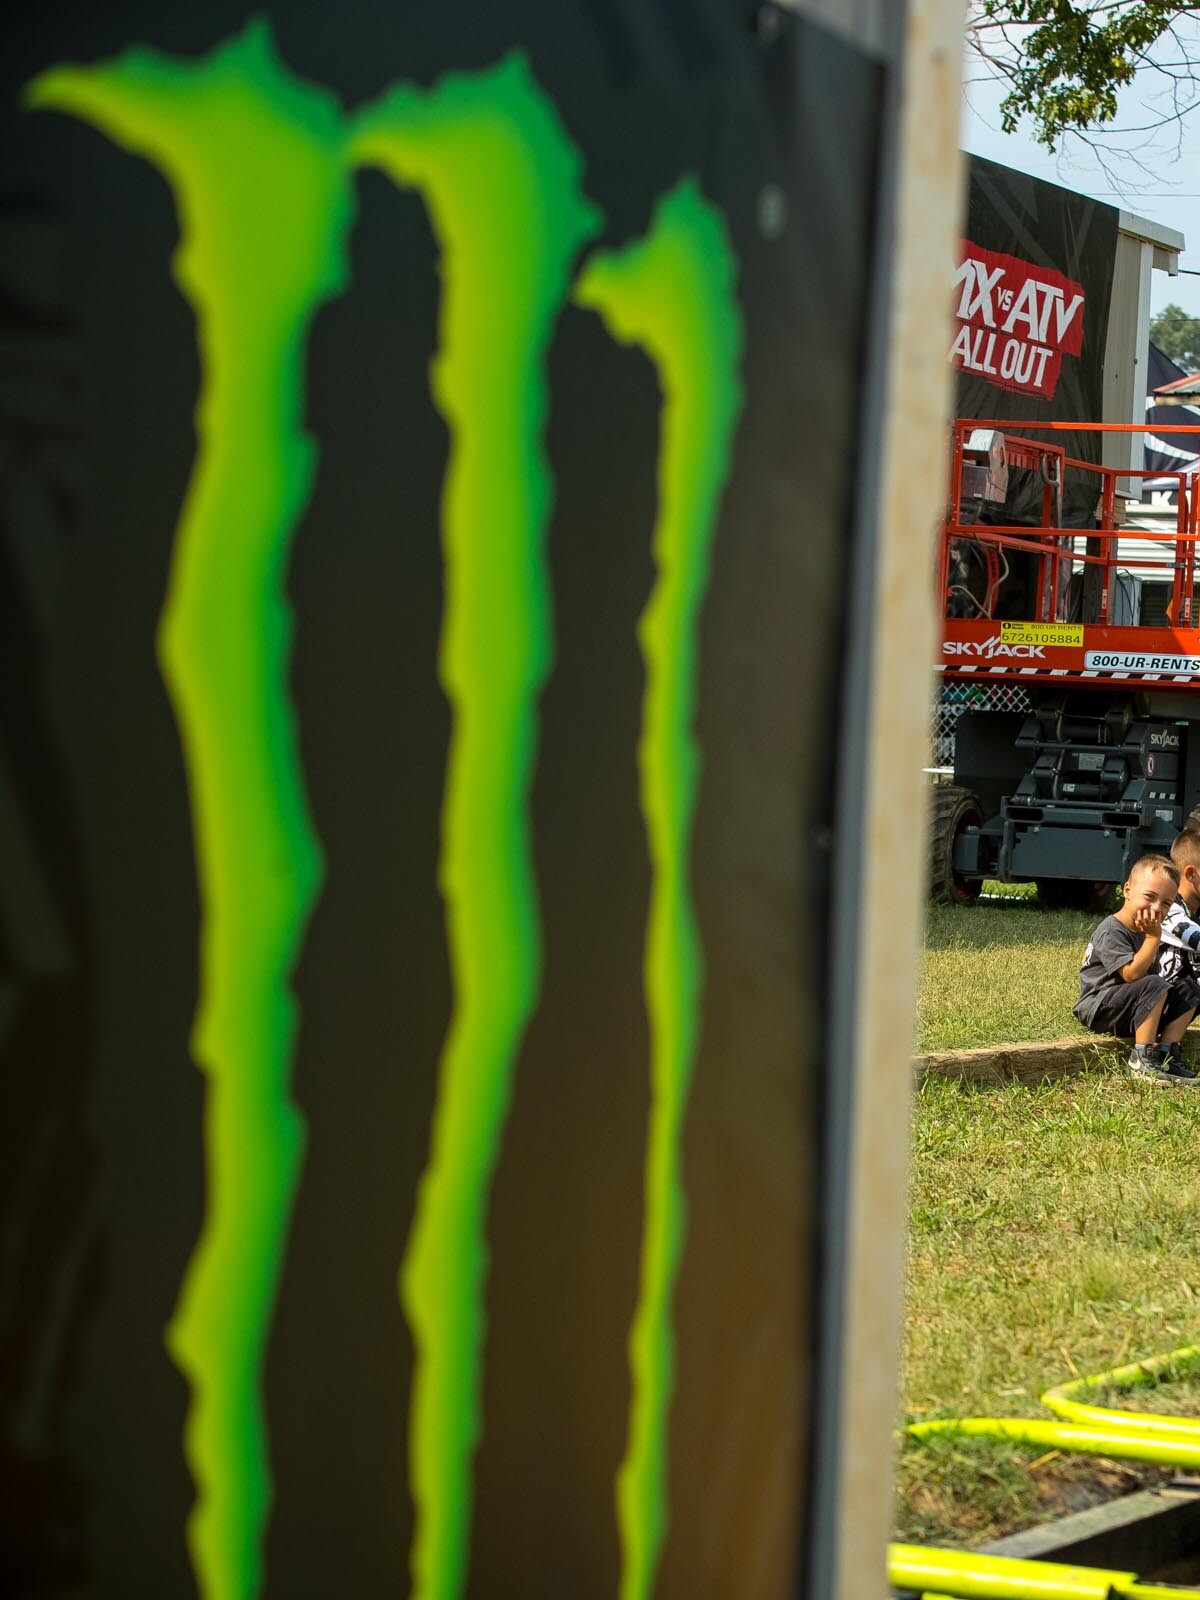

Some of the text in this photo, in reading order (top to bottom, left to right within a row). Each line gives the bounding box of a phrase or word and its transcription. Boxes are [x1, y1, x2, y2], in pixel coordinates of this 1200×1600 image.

[1001, 278, 1085, 344] ATV
[948, 325, 1053, 387] ALL OUT
[943, 635, 1046, 659] SKYJACK
[1002, 633, 1080, 644] 6726105884
[1092, 655, 1200, 671] 800-UR-RENTS
[1150, 729, 1179, 748] SKYJACK
